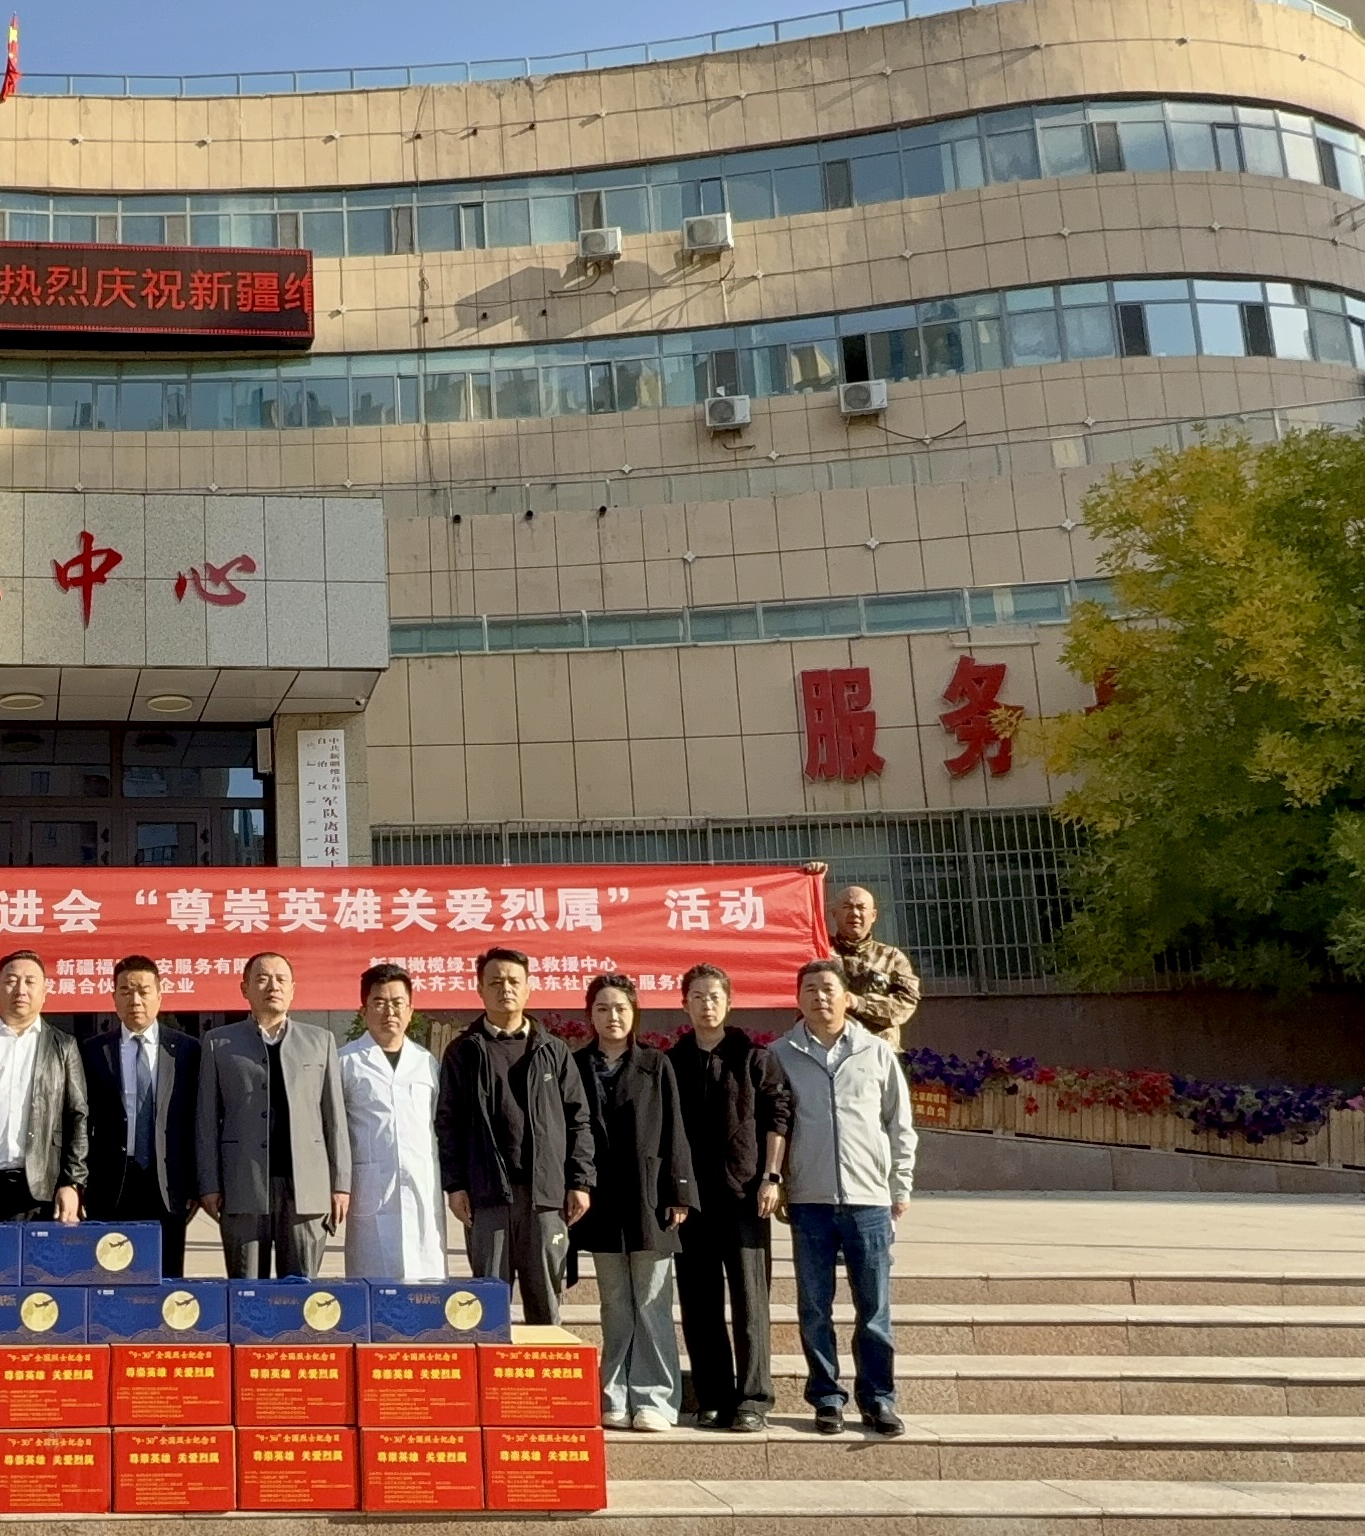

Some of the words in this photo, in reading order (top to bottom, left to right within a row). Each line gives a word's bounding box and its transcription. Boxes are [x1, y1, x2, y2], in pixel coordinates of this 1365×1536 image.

[800, 655, 1116, 782] 服务
[135, 887, 630, 934] “尊崇英雄关爱烈属”
[665, 886, 766, 931] 活动
